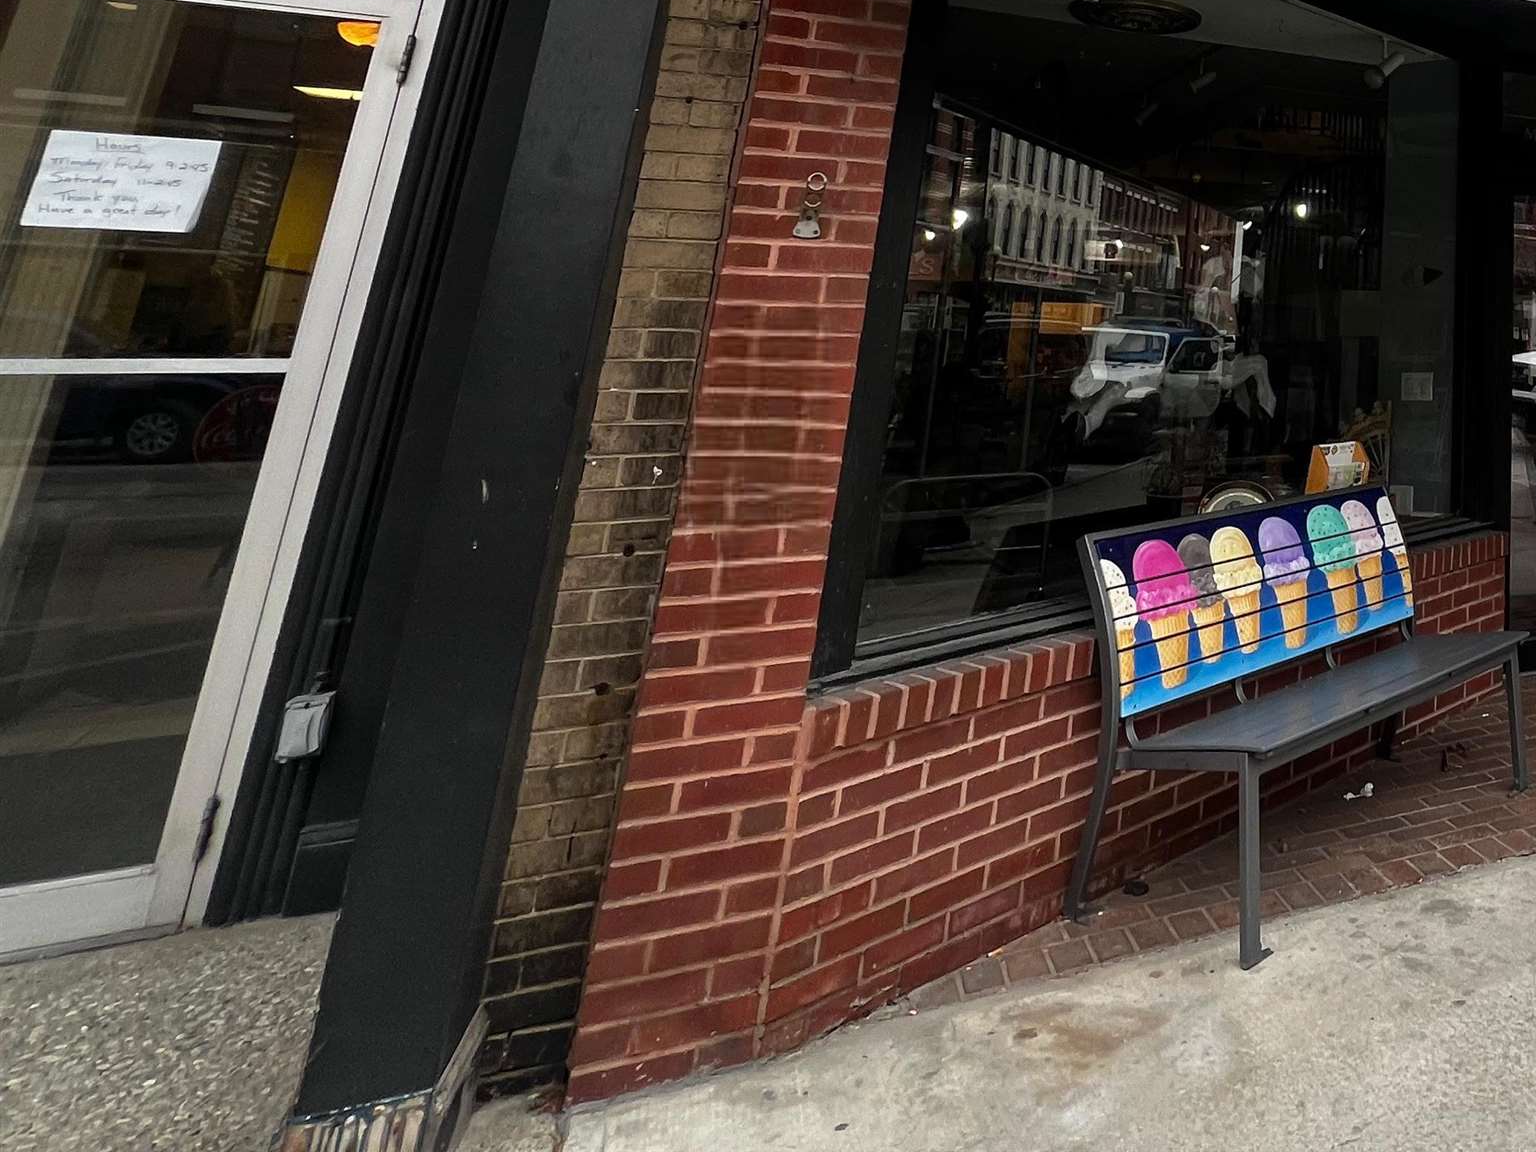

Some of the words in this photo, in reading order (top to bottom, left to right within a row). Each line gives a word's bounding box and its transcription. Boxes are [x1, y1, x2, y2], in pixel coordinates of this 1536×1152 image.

[96, 137, 142, 152] Hours
[48, 171, 117, 188] Saturday
[53, 189, 103, 202] Thank
[38, 203, 73, 213] Have
[102, 205, 136, 217] great
